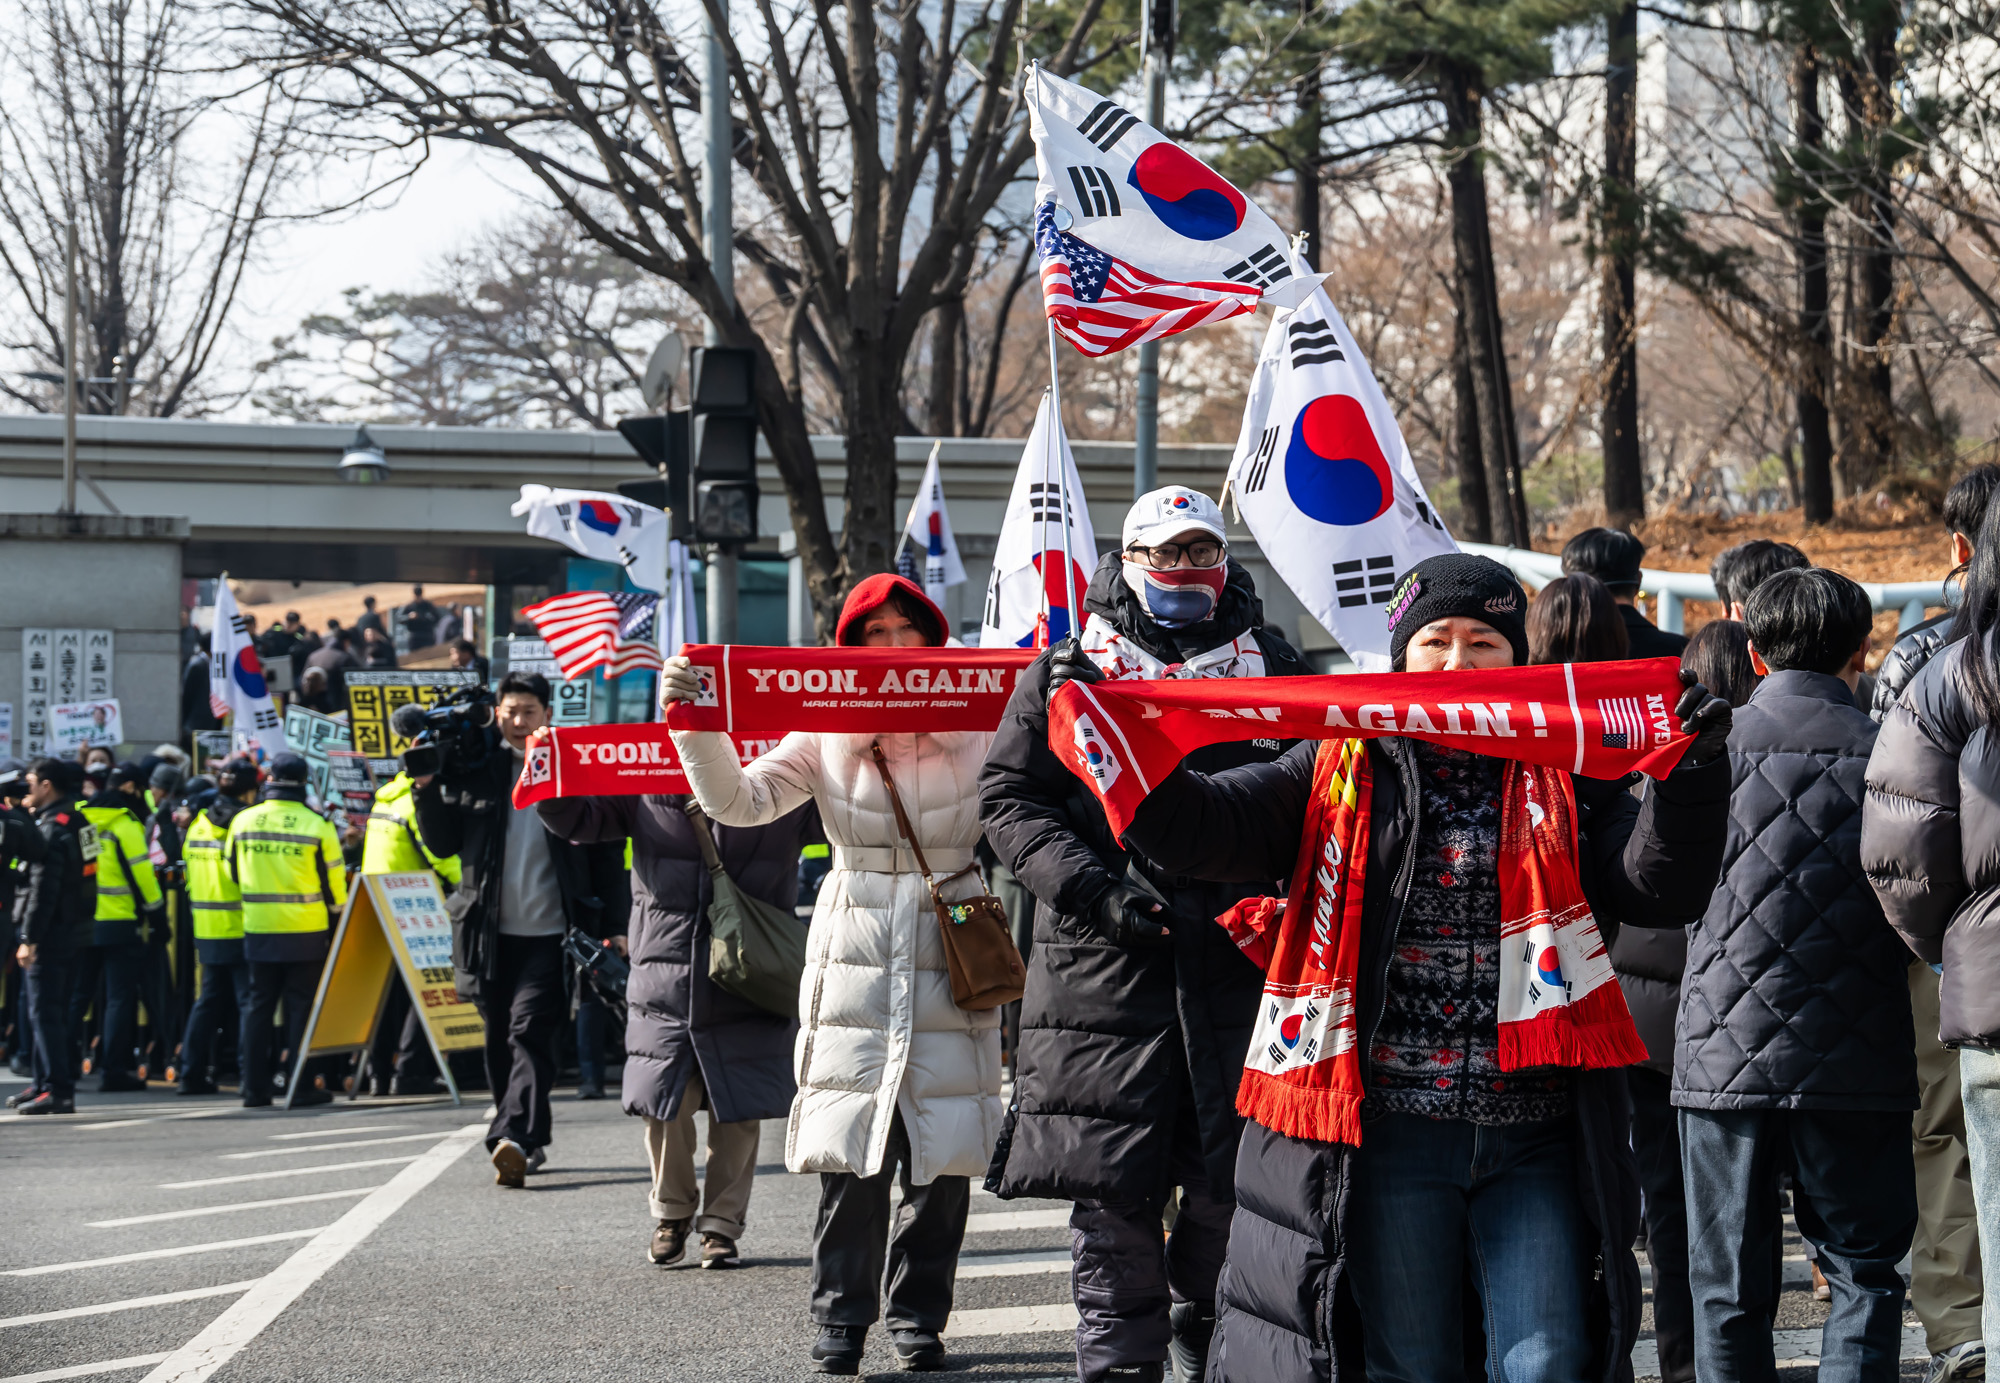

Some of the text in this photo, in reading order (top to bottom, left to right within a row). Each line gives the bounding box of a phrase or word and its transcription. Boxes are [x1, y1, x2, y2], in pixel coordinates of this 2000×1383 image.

[1388, 582, 1420, 631] again
[90, 634, 108, 701] 서울고
[747, 669, 868, 696] YOON,
[802, 700, 968, 708] MAKE KOREA GREAT AGAIN
[572, 742, 671, 766] YOON,
[1251, 738, 1280, 751] KOREA
[244, 843, 304, 857] POLICE
